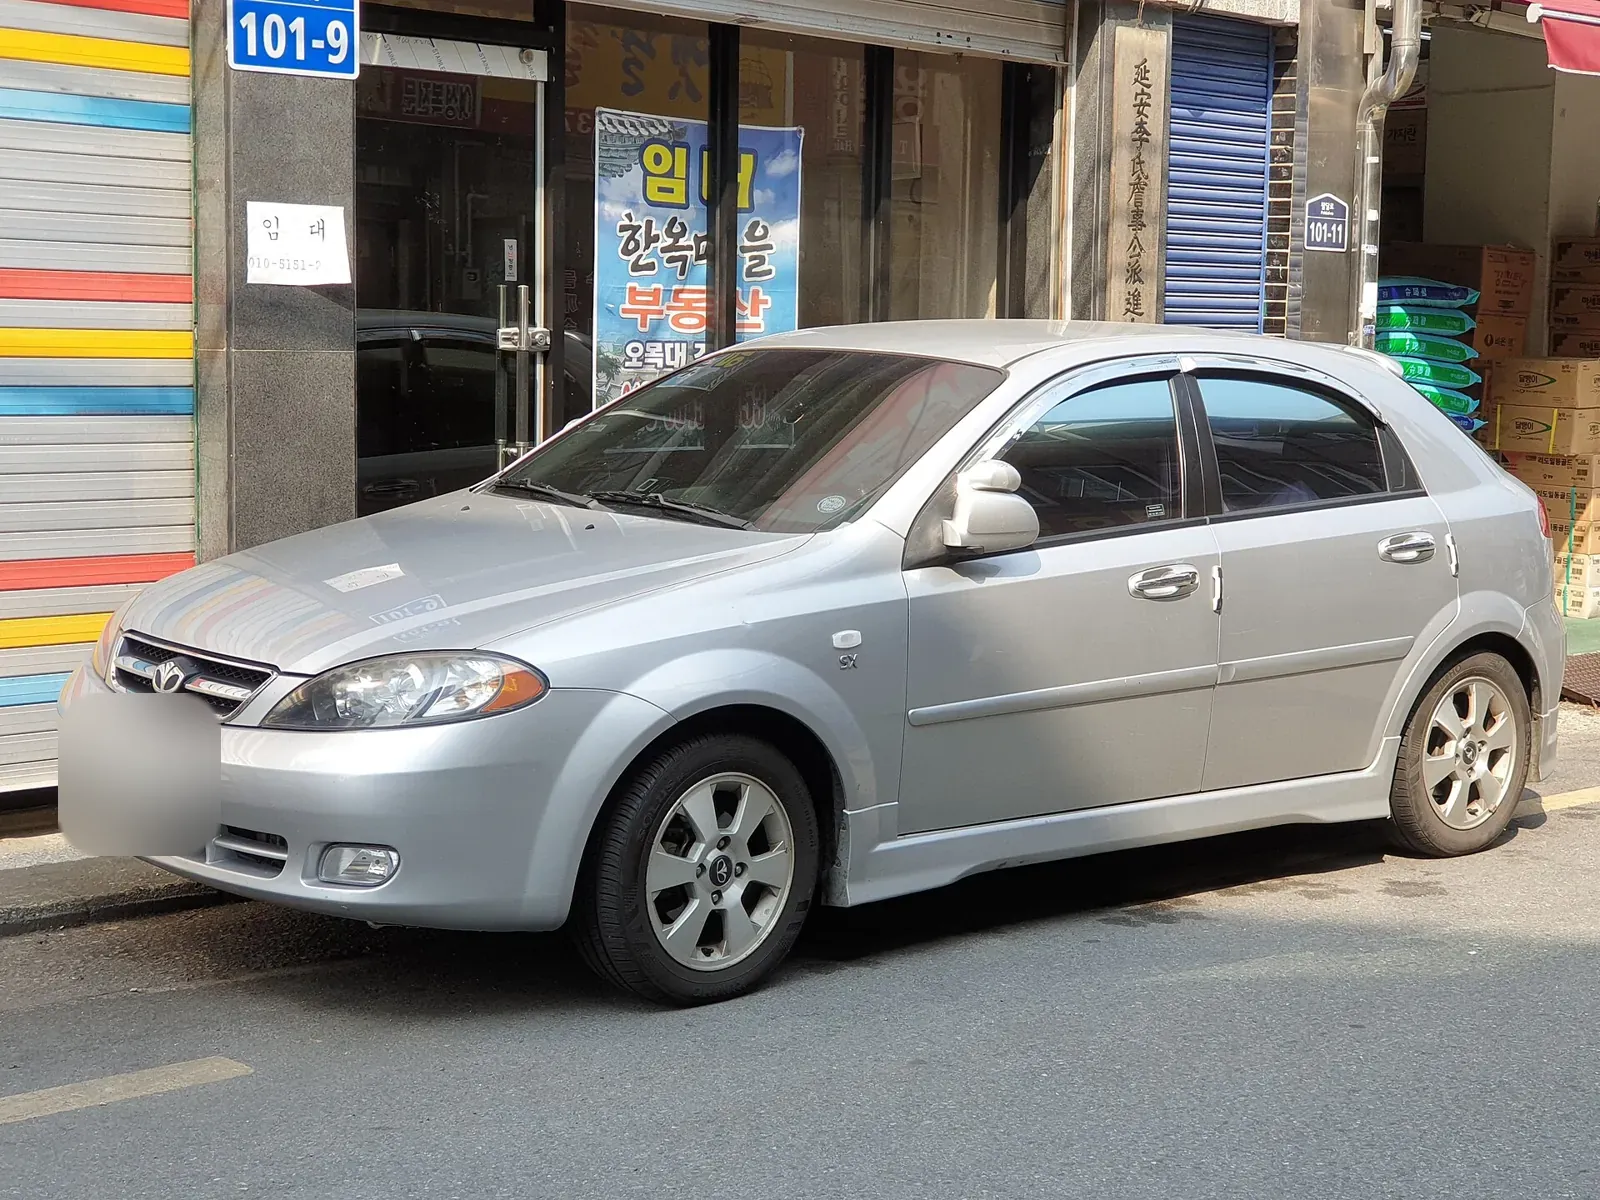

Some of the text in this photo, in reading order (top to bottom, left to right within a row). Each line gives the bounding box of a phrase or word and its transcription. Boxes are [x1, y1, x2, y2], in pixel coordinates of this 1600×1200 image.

[239, 11, 349, 65] 101-9
[1309, 221, 1343, 244] 101-11
[624, 341, 688, 369] 오목대
